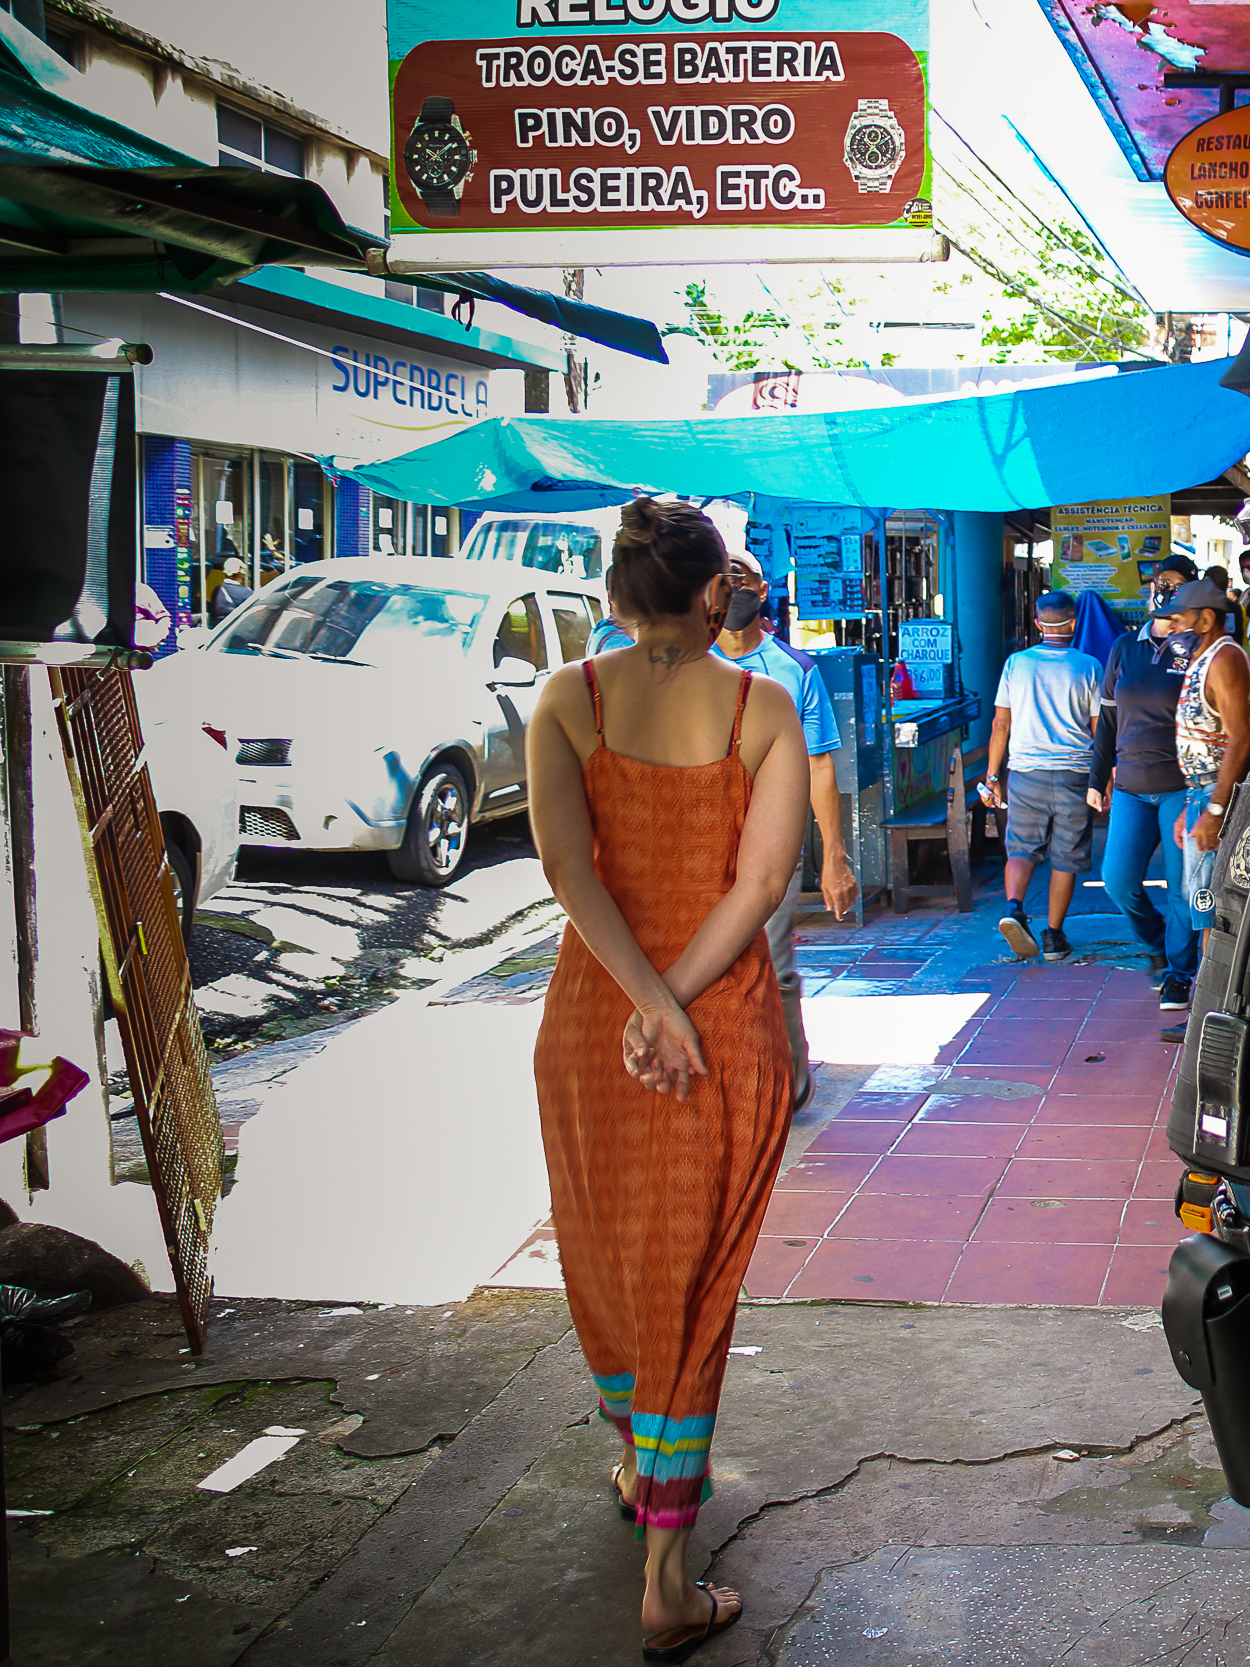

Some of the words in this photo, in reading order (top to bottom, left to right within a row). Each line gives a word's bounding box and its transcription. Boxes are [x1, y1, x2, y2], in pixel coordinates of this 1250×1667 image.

[477, 42, 666, 87] TROCA-SE
[673, 40, 845, 83] BATERIA
[515, 105, 641, 153] PINO,
[647, 103, 795, 145] VIDRO
[490, 166, 707, 218] PULSEIRA,
[714, 164, 825, 213] ETC..
[331, 345, 488, 418] SUPERBELA
[1057, 505, 1120, 515] ASSISTÊNCIA
[1123, 504, 1164, 513] TÉCNICA
[902, 627, 949, 637] ARROZ
[912, 638, 937, 648] COM
[901, 649, 950, 661] CHARQUE
